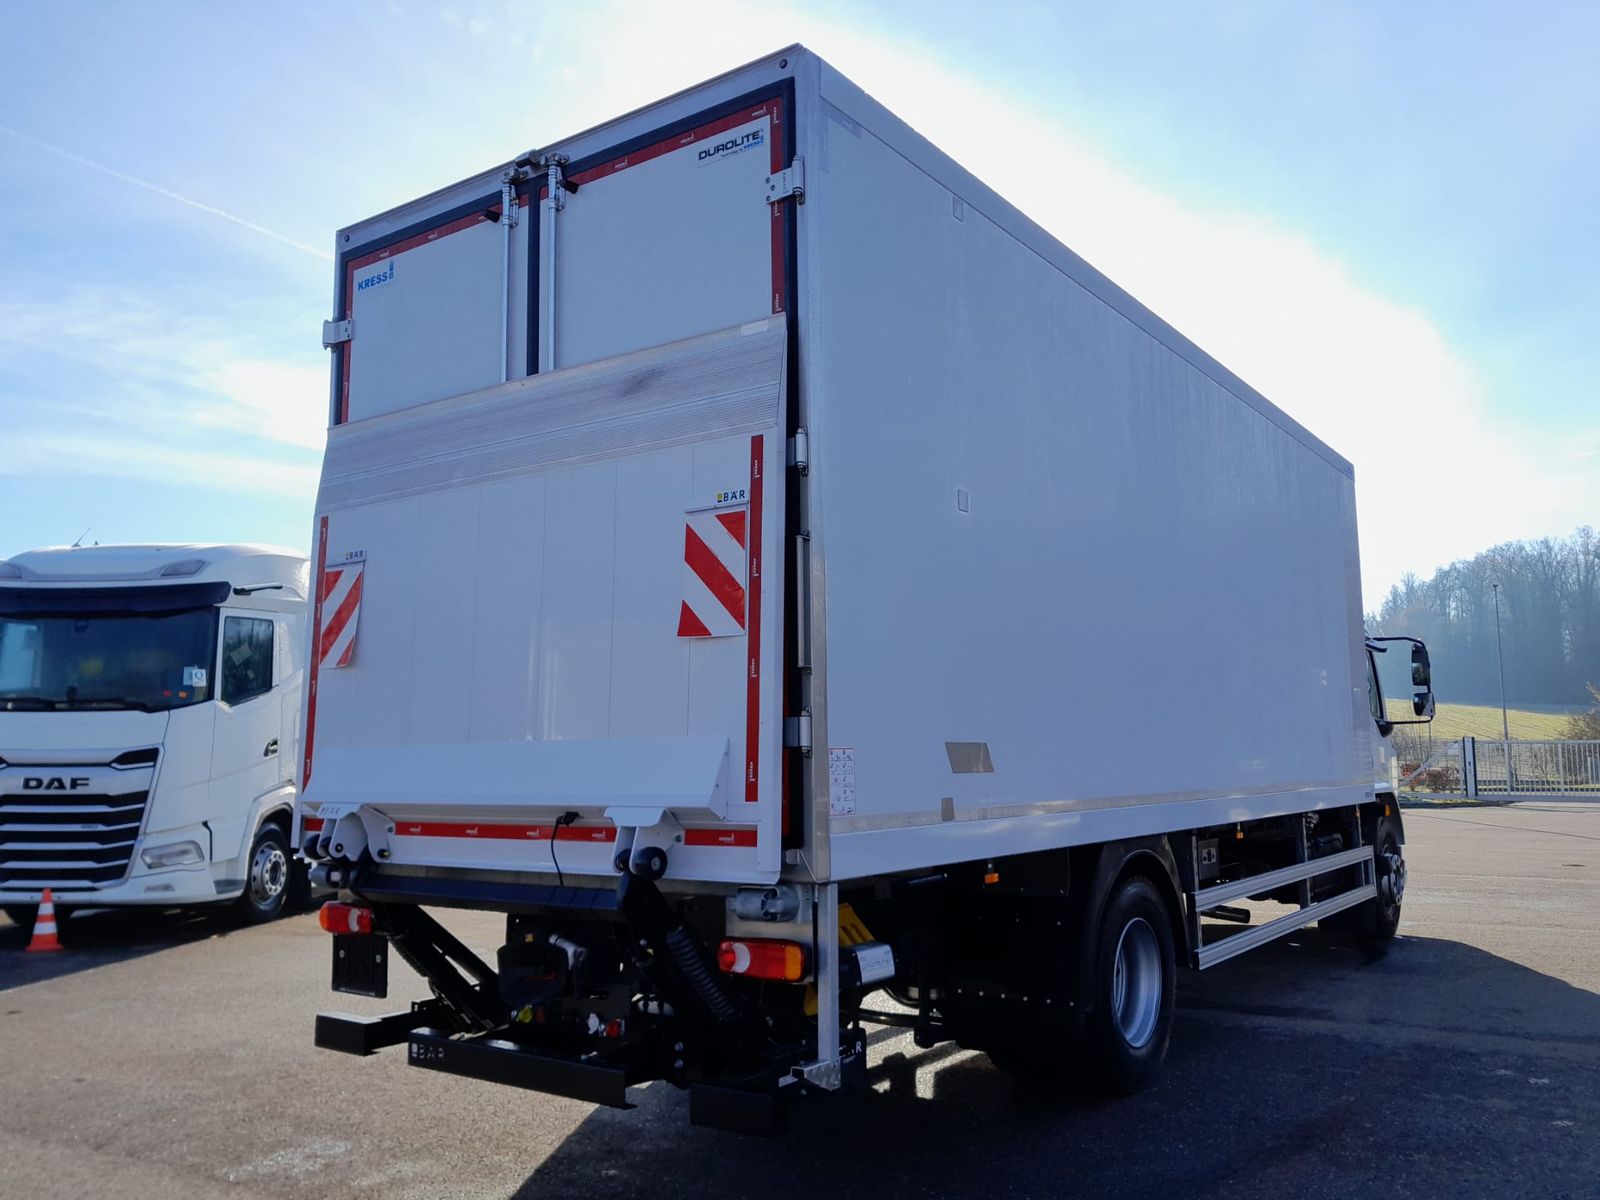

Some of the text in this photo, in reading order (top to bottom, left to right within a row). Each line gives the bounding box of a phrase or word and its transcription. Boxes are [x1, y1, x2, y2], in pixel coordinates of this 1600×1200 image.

[698, 130, 760, 160] DUROLITE
[357, 271, 388, 291] KRESS
[723, 489, 746, 502] BÄR
[22, 777, 90, 790] DAF
